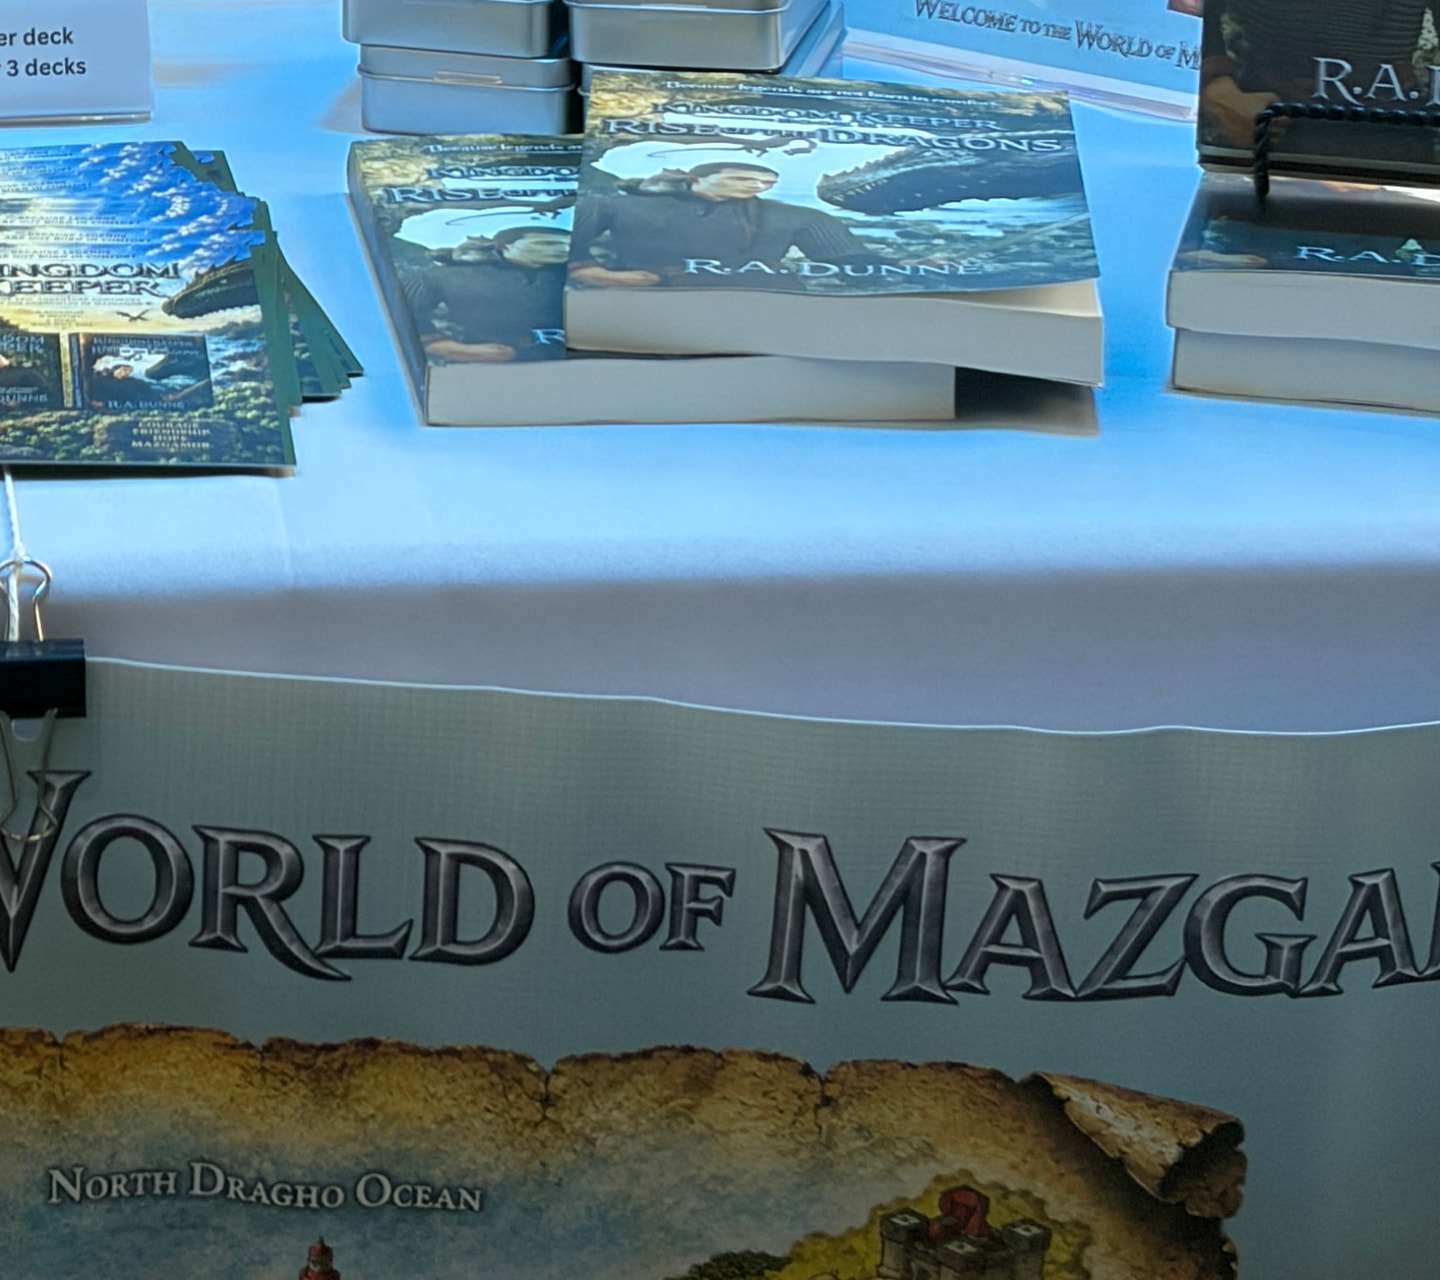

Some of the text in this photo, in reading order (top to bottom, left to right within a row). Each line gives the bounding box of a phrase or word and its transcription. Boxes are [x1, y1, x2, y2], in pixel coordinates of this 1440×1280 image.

[23, 26, 73, 46] deck
[7, 60, 18, 76] 3
[25, 57, 86, 76] decks
[652, 103, 1001, 130] KINGDOM KEEPER
[812, 126, 1062, 151] DRAGONS
[797, 262, 983, 278] DUNNE
[567, 861, 737, 952] OF
[748, 827, 1440, 1004] MAZGA
[48, 1162, 483, 1212] NORTH DRAGHO OCEAN
